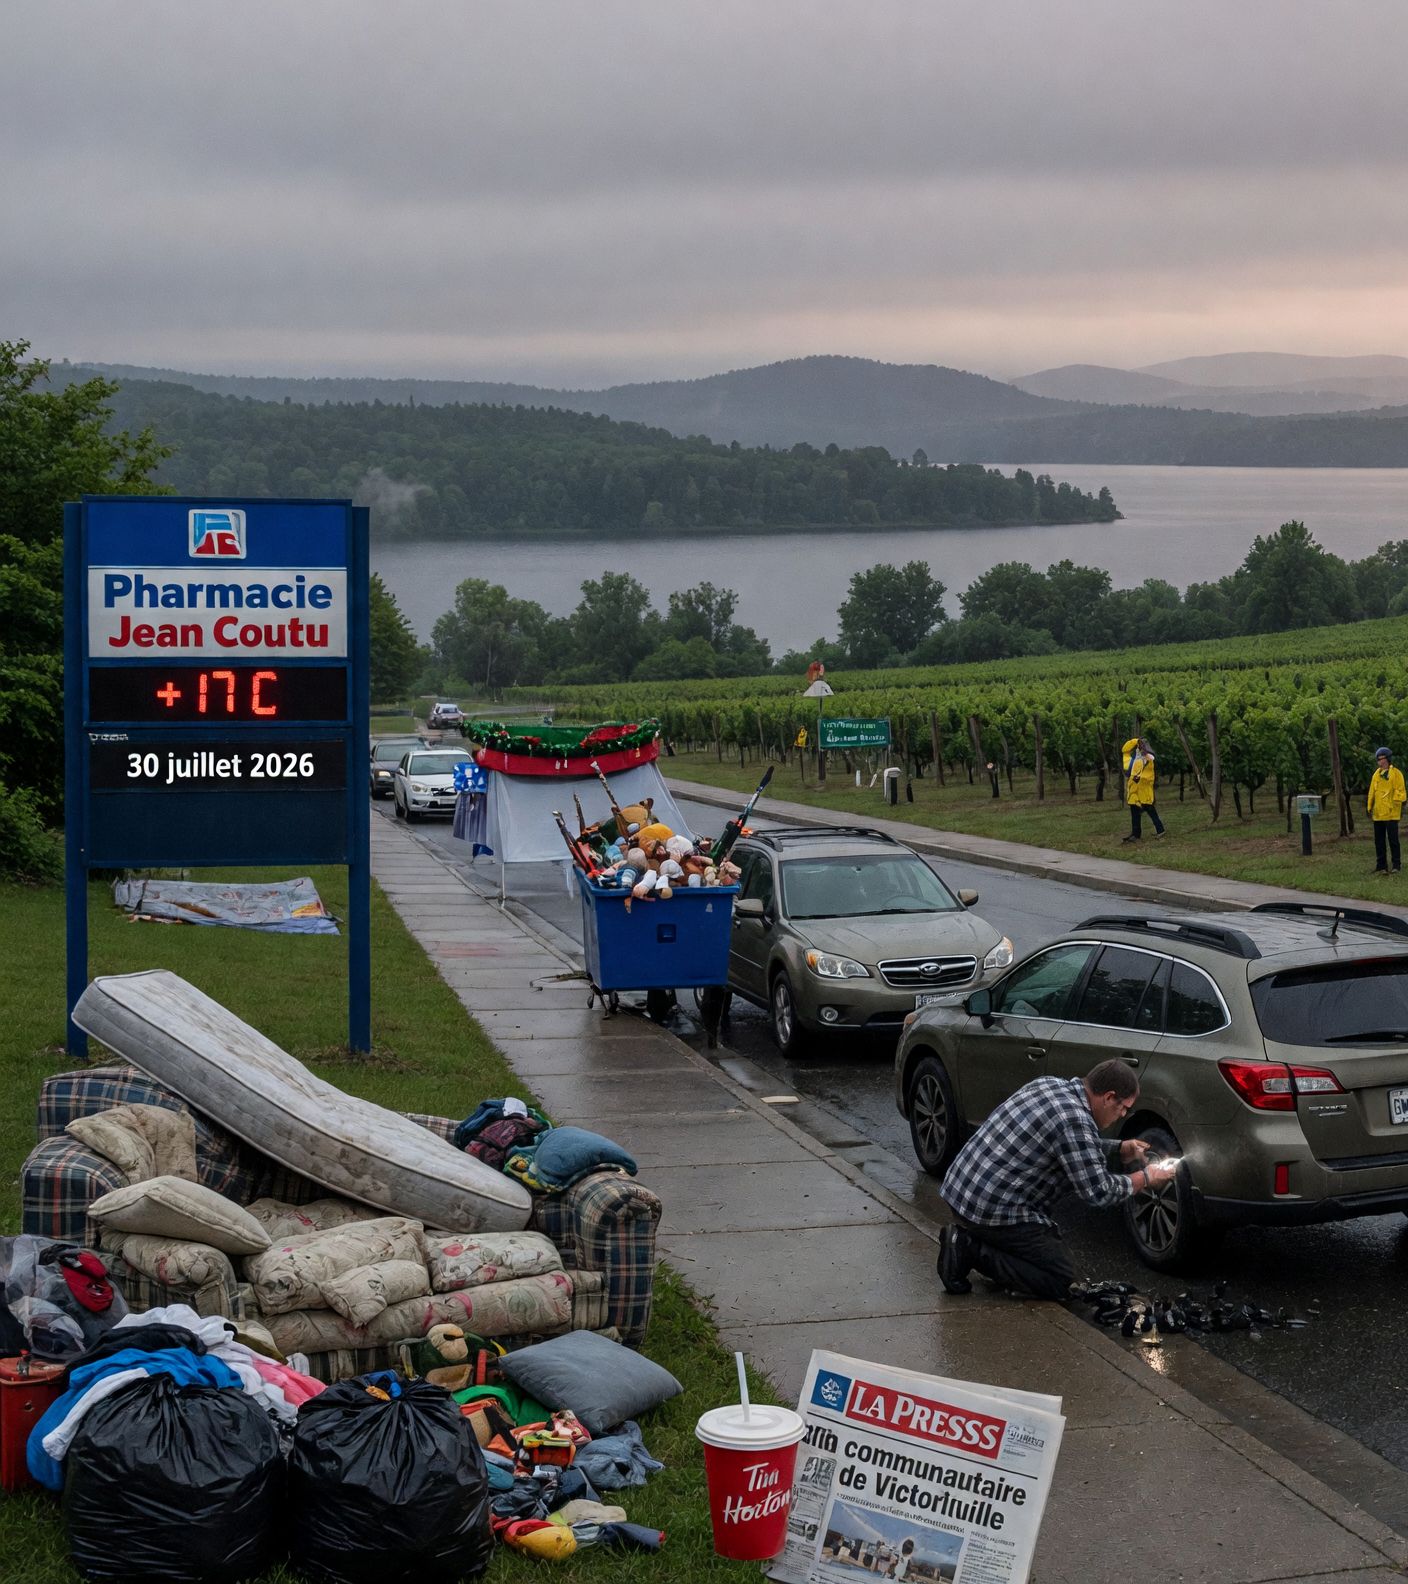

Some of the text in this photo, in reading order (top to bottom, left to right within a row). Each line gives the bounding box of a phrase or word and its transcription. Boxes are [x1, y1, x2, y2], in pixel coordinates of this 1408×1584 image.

[104, 574, 332, 609] Pharmacie
[108, 615, 329, 648] Jean Coutu
[127, 752, 315, 784] 30 juillet 2026
[851, 1386, 886, 1422] LA
[890, 1396, 1000, 1450] PRESSS
[839, 1464, 867, 1491] de
[844, 1440, 1027, 1506] communautaire
